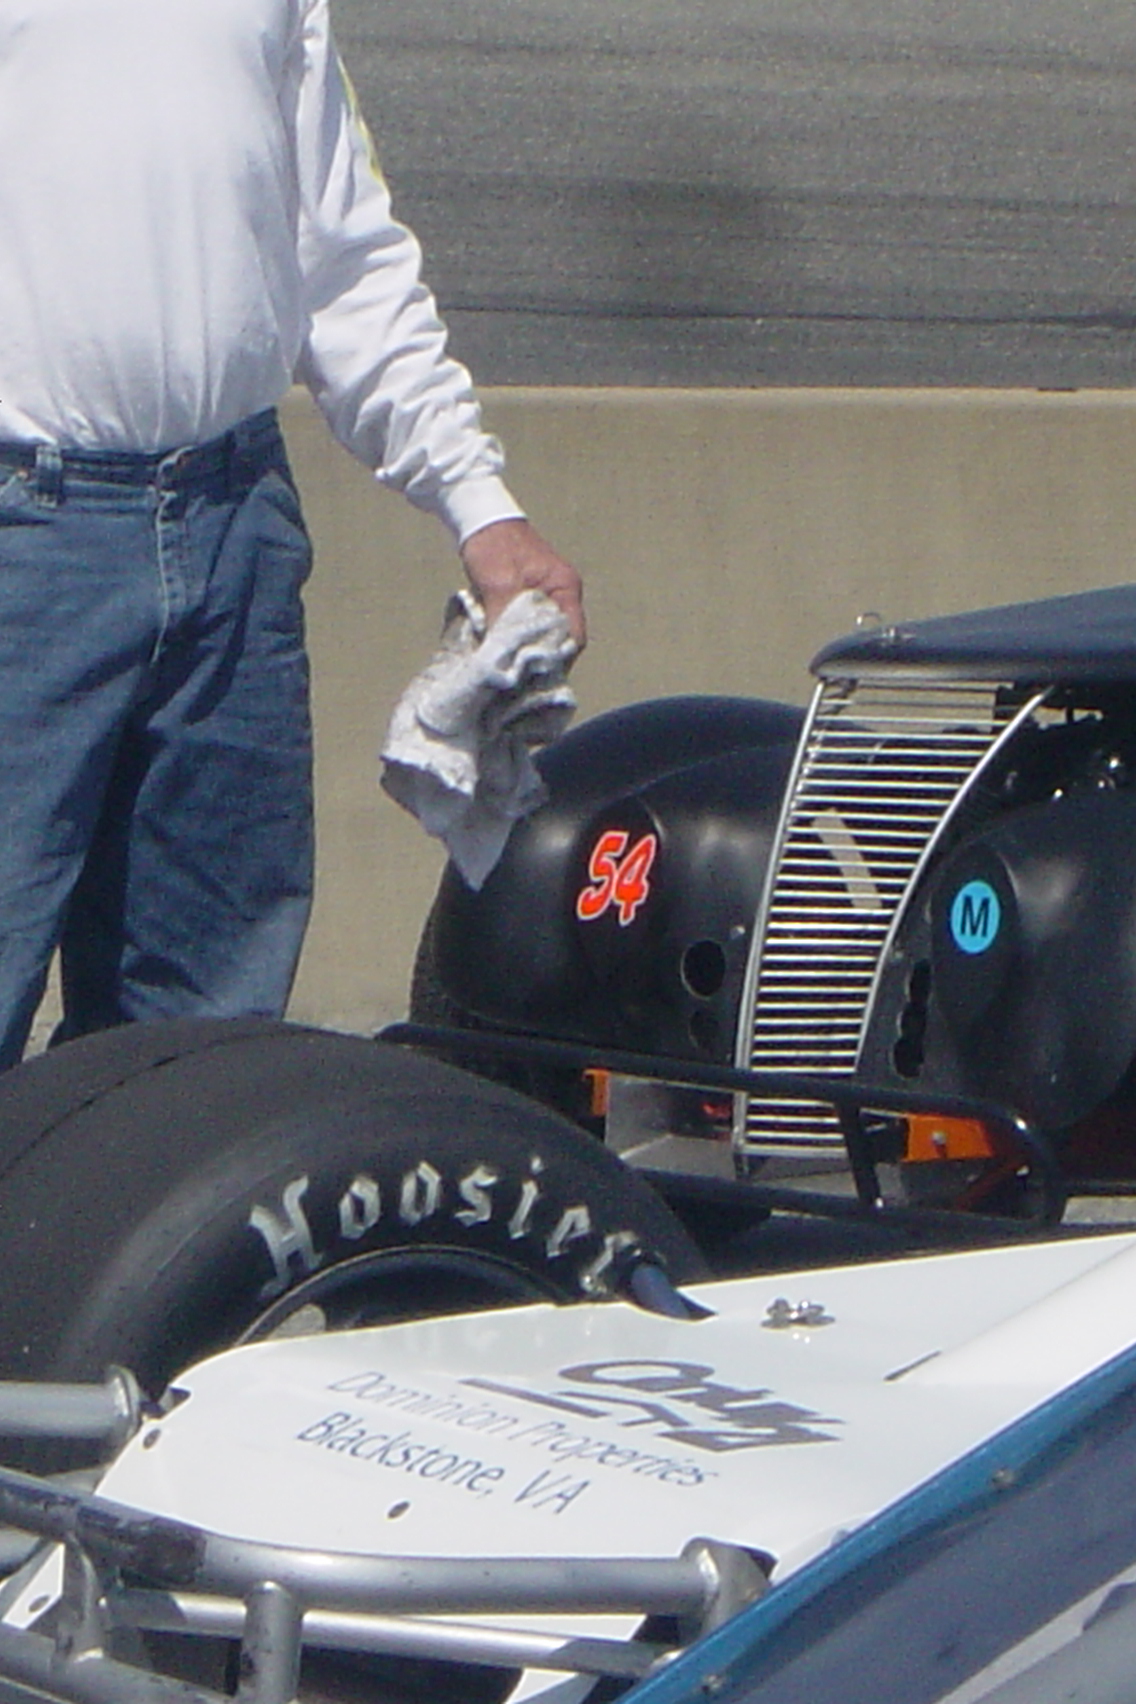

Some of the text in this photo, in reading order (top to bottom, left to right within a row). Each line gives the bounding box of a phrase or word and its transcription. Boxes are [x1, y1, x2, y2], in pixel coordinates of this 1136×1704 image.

[576, 831, 657, 927] 54
[957, 897, 990, 938] M
[249, 1155, 640, 1299] Hoosier
[296, 1411, 592, 1515] Blackstone, VA
[326, 1371, 720, 1487] Dominion Properties
